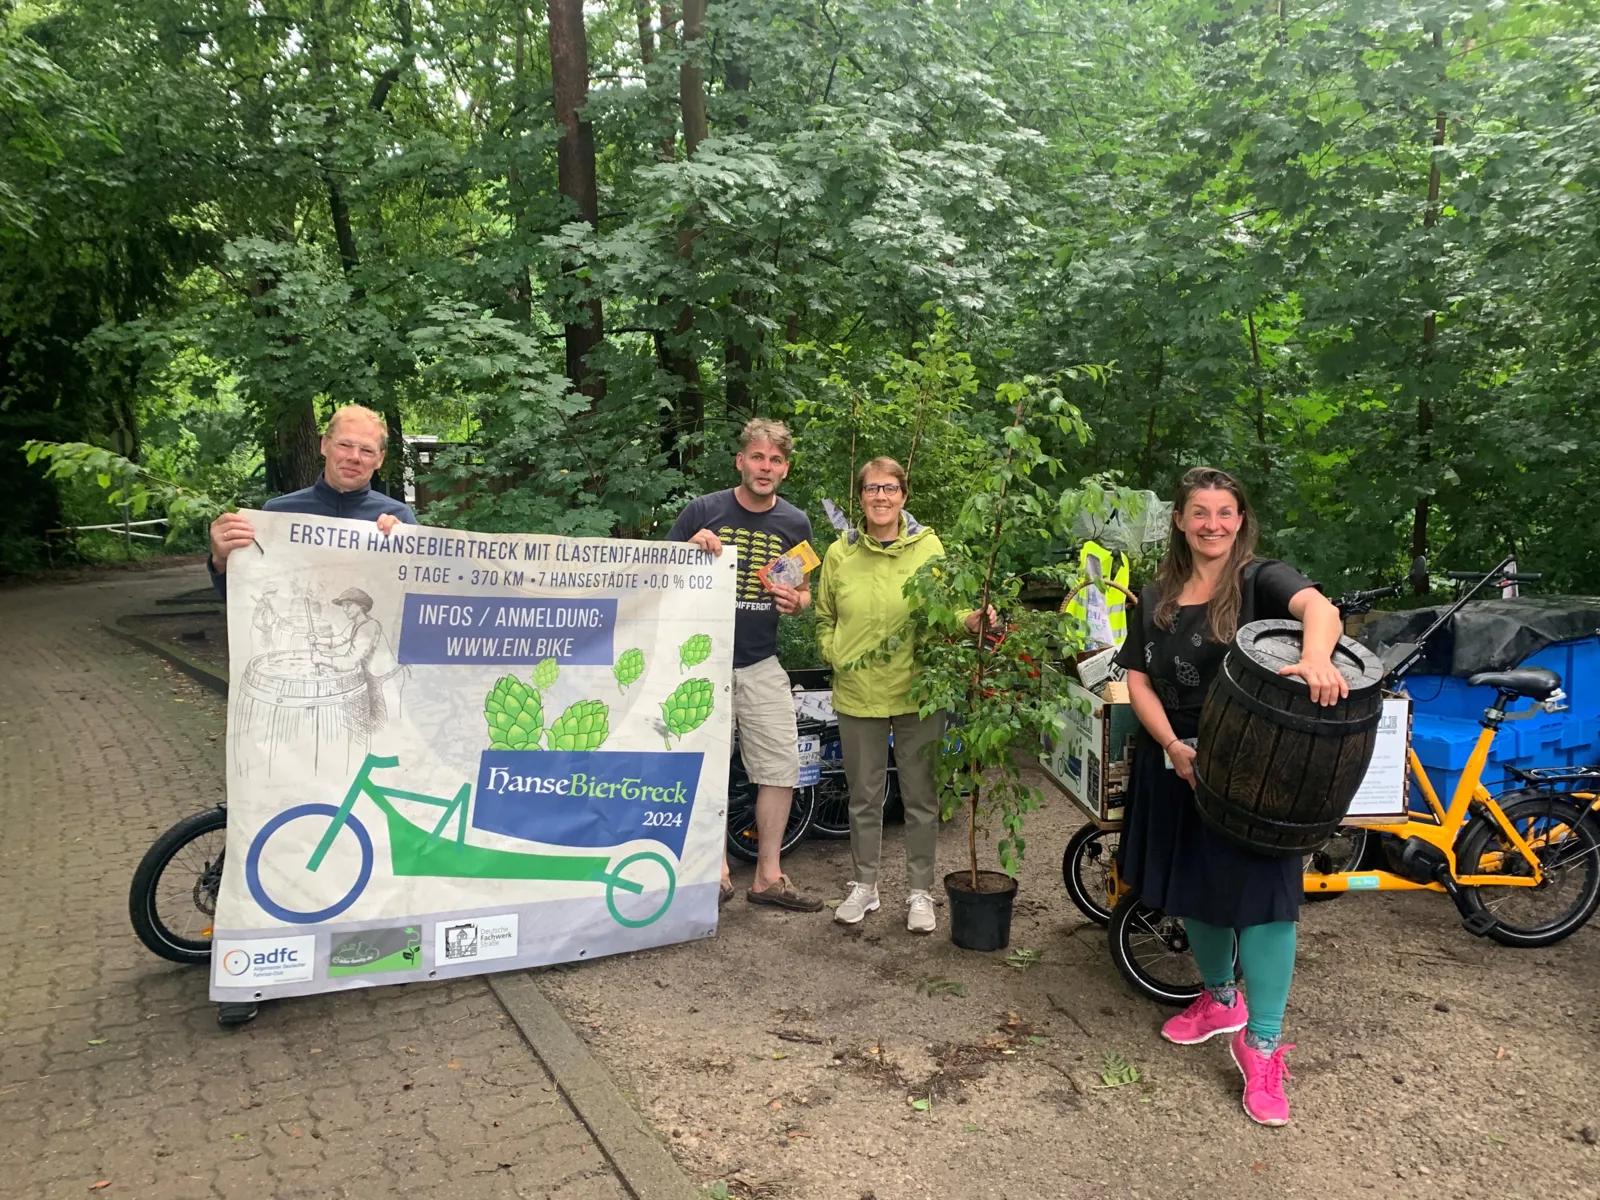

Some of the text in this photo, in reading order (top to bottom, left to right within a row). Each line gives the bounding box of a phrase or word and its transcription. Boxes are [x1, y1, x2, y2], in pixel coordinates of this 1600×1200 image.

[290, 523, 360, 550] ERSTER
[367, 531, 518, 560] HANSEBIERTRECK
[524, 542, 551, 561] MIT
[398, 565, 407, 581] 9
[414, 565, 451, 583] TAGE
[471, 570, 498, 586] 370
[503, 571, 524, 586] KM
[551, 571, 638, 588] HANSESTÄDTE
[673, 574, 684, 589] %
[689, 575, 713, 590] CO2
[418, 604, 604, 628] INFOS / ANMELDUNG:
[446, 636, 575, 657] WWW.EIN.BIKE
[642, 811, 683, 828] 2024
[480, 926, 509, 935] Deutsche
[480, 932, 512, 942] Fachwerk
[253, 947, 298, 965] adfc
